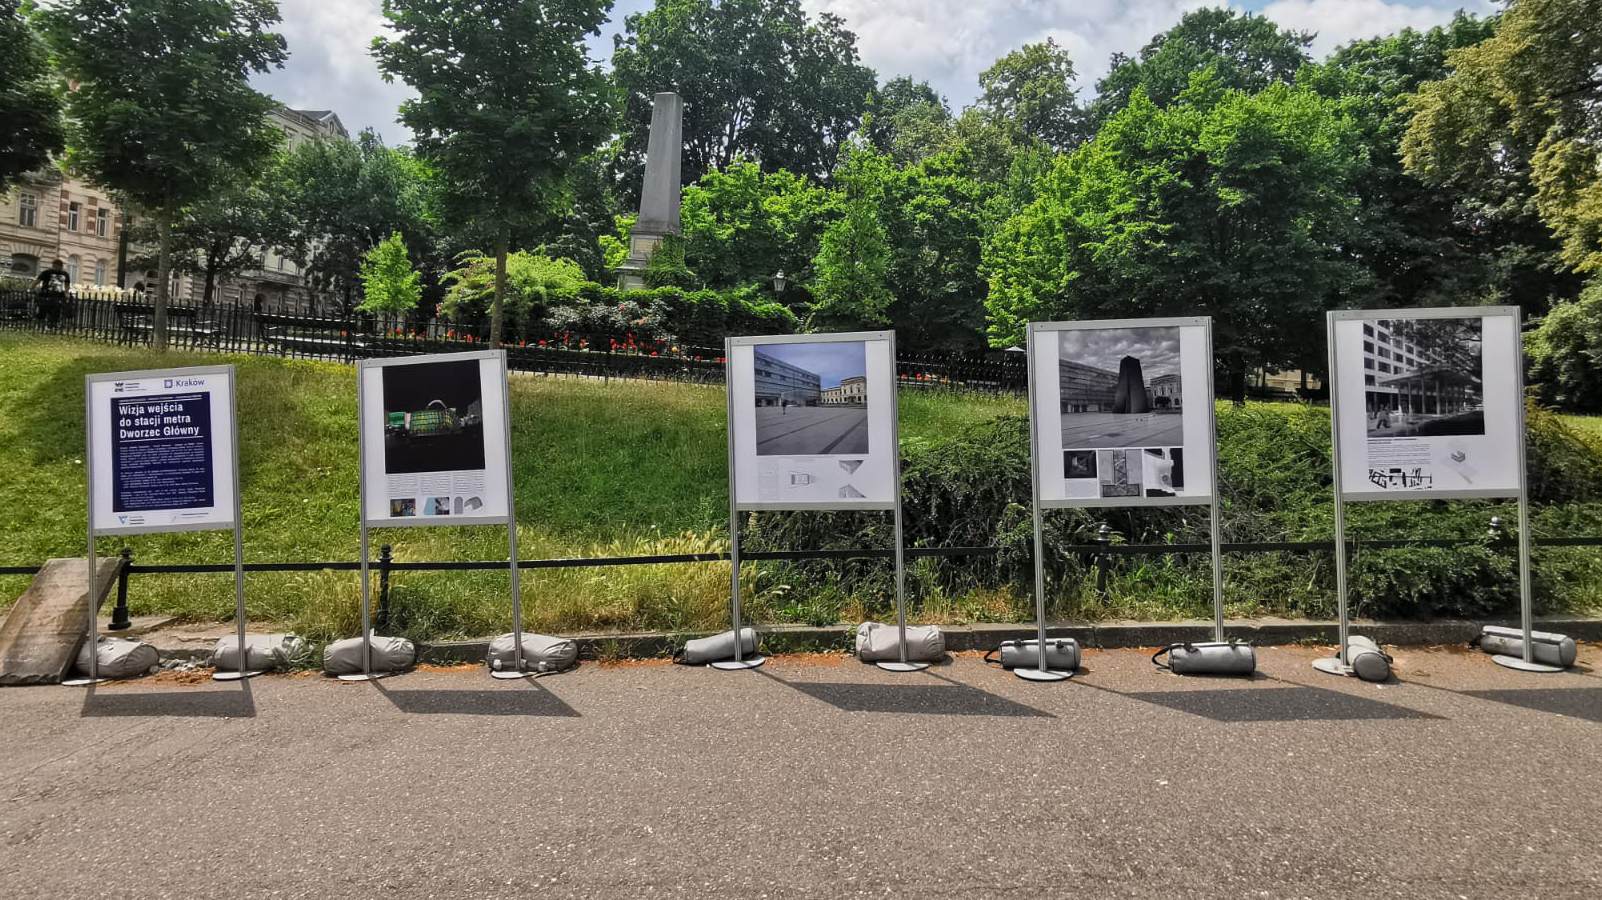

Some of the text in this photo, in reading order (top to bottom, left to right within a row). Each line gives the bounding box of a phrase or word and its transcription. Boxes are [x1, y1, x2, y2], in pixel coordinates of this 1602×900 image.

[176, 378, 205, 388] Kraków
[119, 403, 183, 416] Wizja wejścia
[119, 415, 191, 427] do stacji metra
[120, 426, 200, 439] Dworzec Główny
